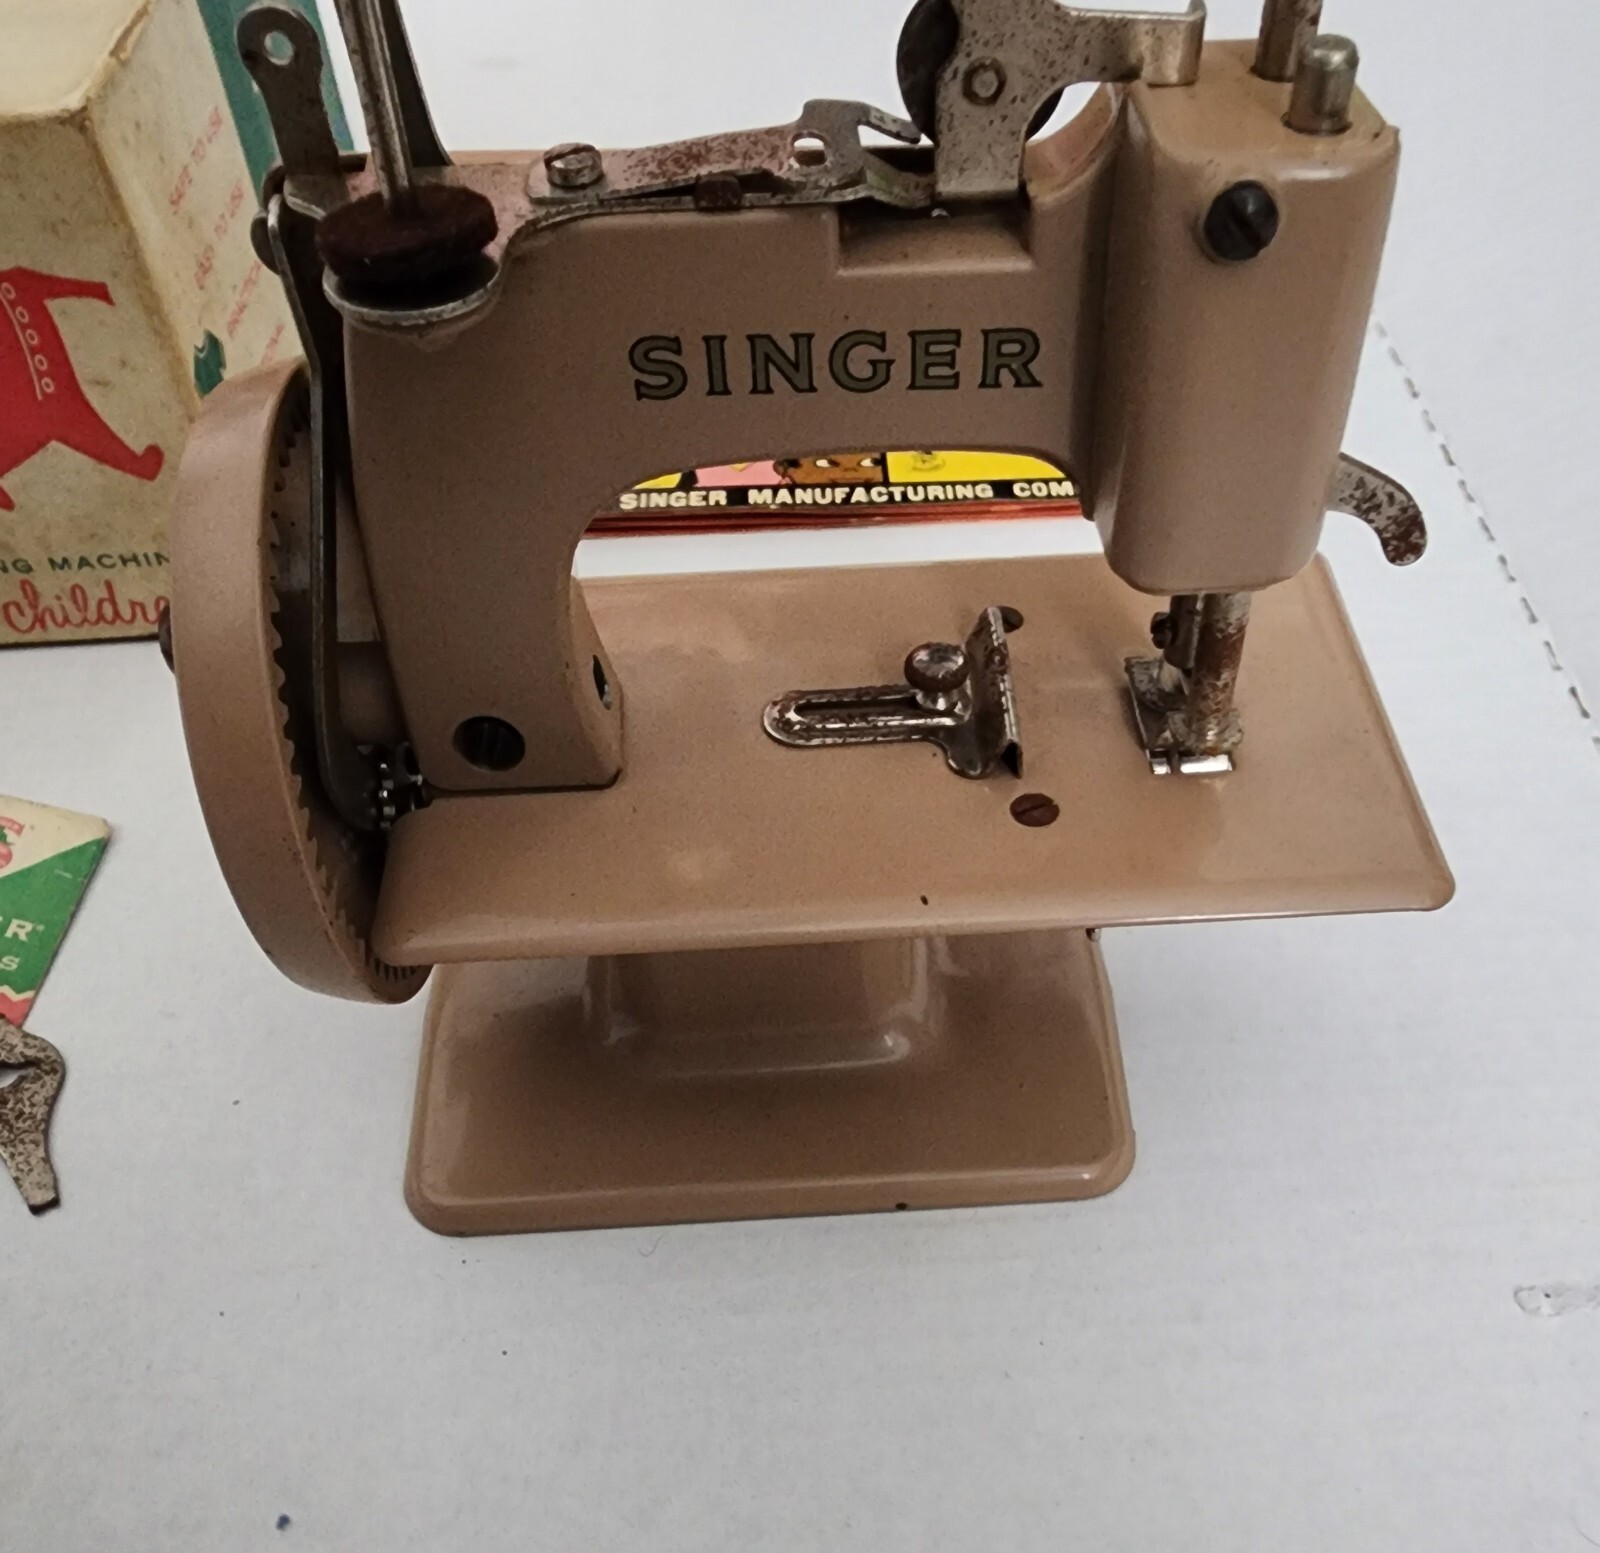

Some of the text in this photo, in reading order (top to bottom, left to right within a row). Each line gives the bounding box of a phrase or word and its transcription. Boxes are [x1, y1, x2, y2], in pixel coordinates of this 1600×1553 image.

[628, 327, 1043, 401] SINGER
[619, 488, 727, 510] SINGER
[748, 483, 994, 507] MANUFACTURING
